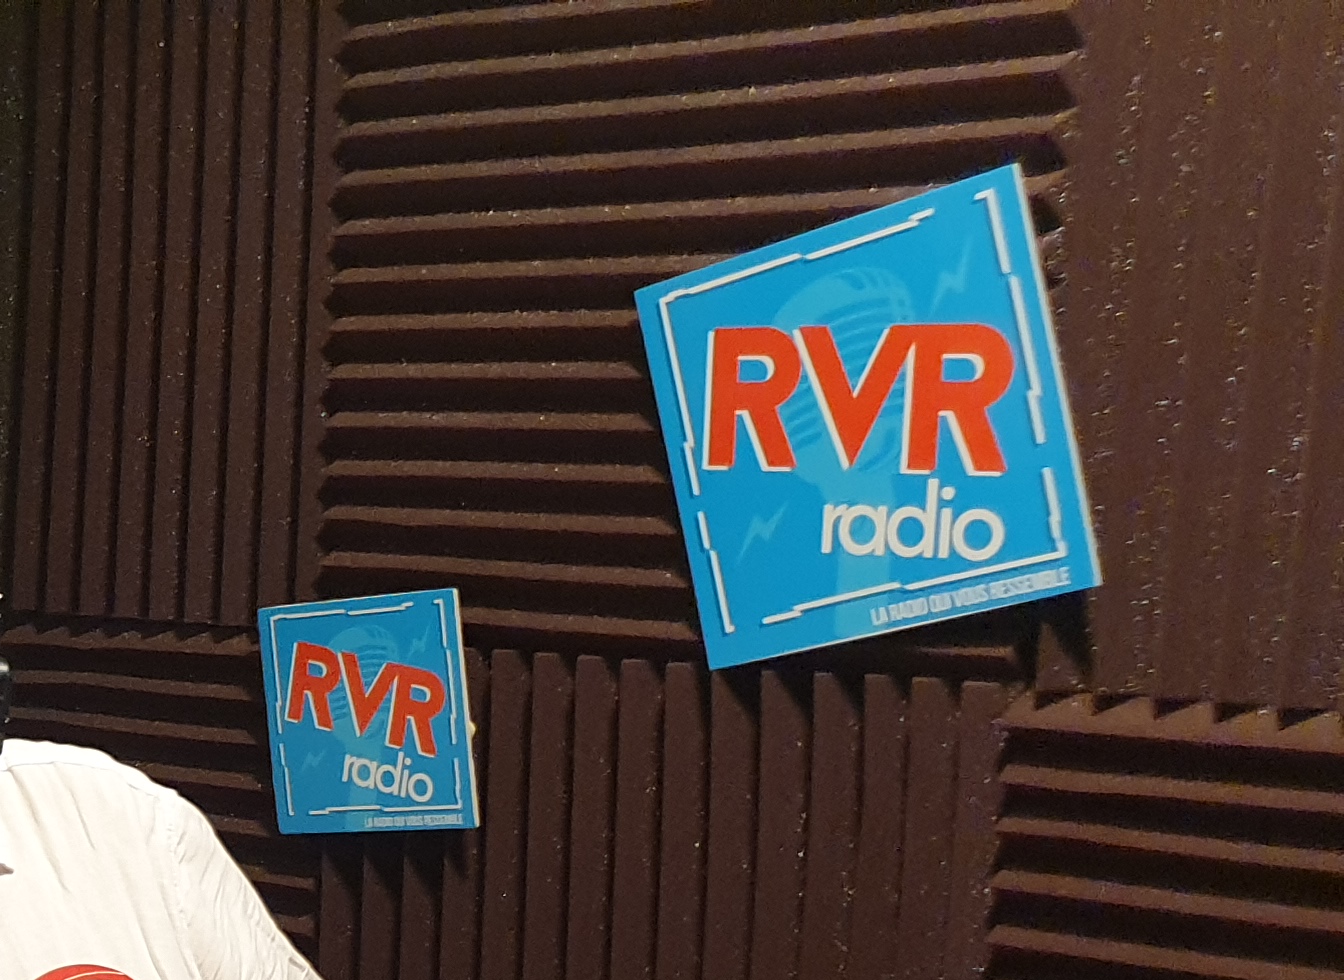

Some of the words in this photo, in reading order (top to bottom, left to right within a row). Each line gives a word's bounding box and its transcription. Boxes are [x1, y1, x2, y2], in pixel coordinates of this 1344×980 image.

[701, 323, 1015, 477] RVR
[820, 478, 1006, 562] radio
[284, 640, 447, 758] RVR
[341, 751, 434, 803] radio
